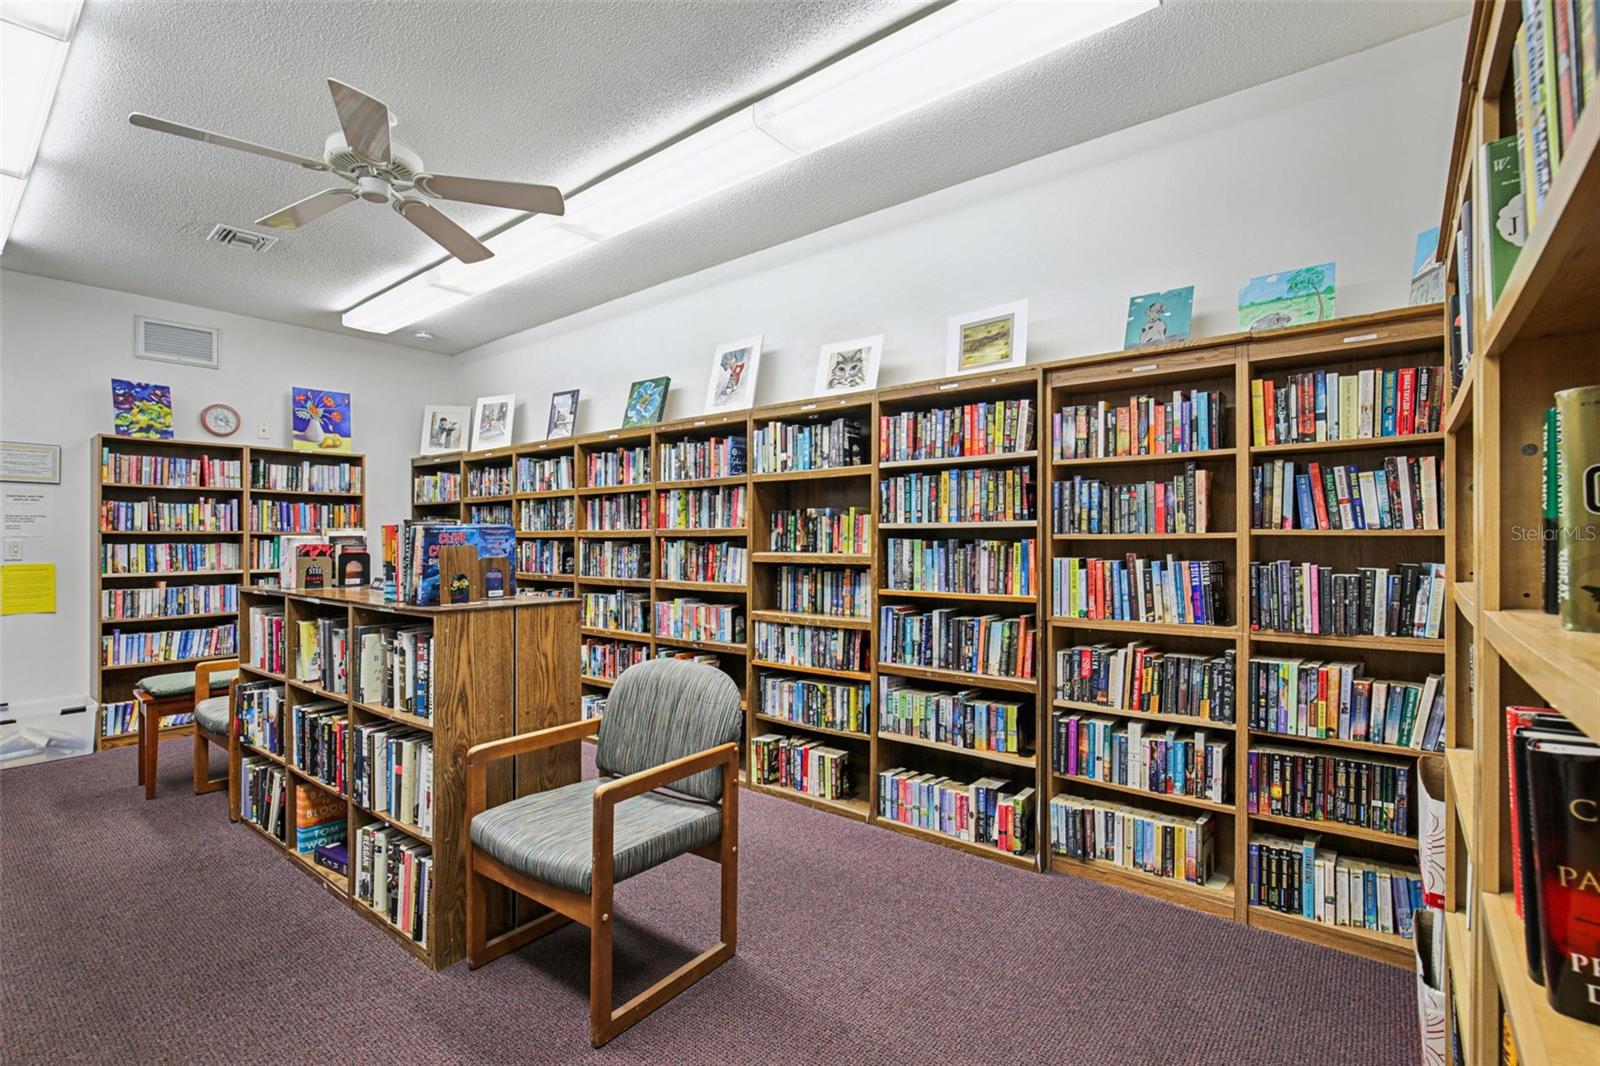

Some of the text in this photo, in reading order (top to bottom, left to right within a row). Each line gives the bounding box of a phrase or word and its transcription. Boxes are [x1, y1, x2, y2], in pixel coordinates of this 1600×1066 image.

[306, 802, 346, 818] BLOOD
[314, 826, 340, 839] TOM
[361, 835, 370, 867] REAGAN
